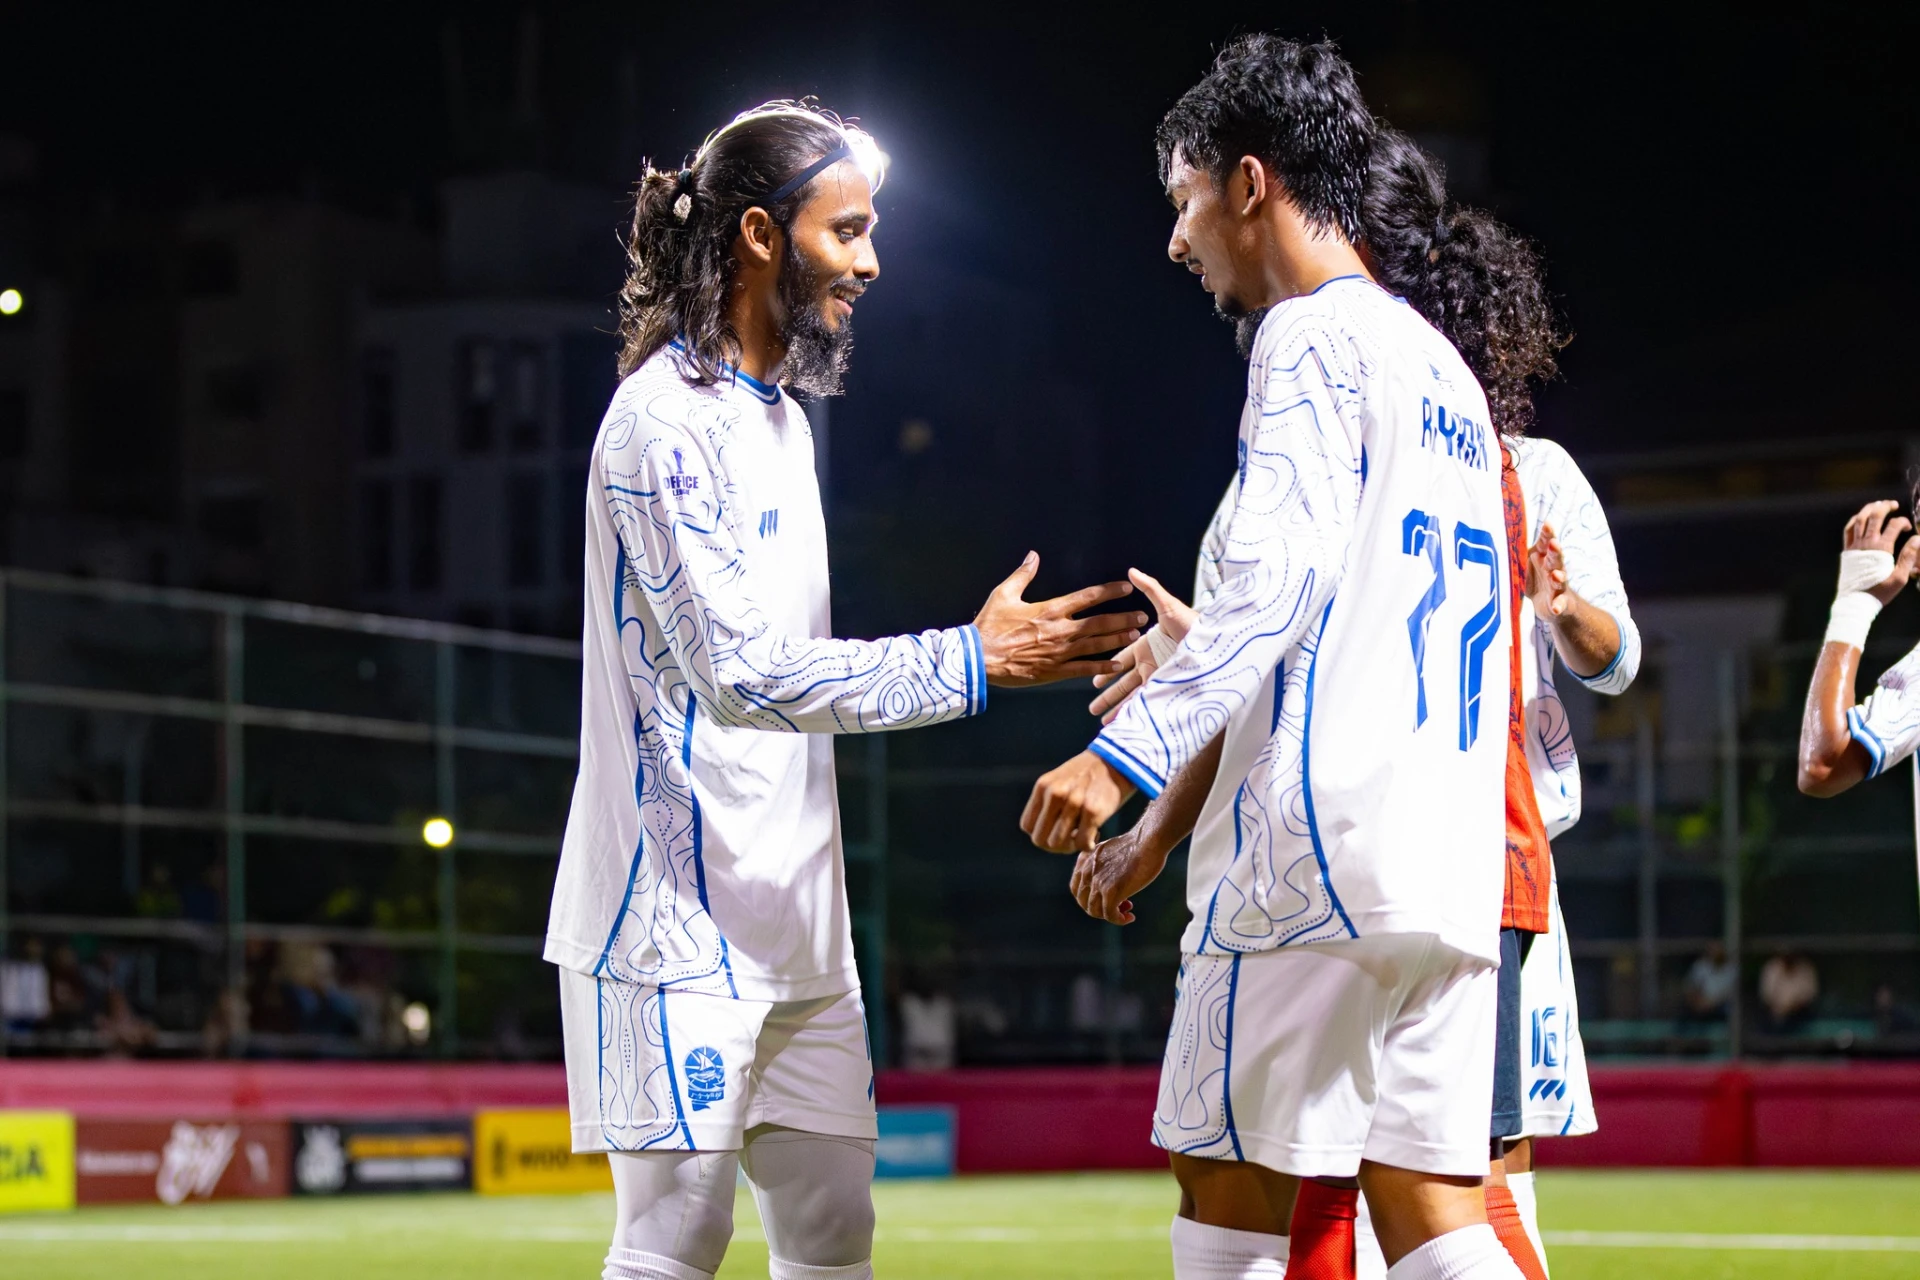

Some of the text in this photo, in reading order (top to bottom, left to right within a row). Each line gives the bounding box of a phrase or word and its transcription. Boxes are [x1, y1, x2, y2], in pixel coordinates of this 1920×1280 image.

[663, 475, 699, 489] OFFICE
[1402, 508, 1501, 752] 77
[1531, 1006, 1559, 1068] 16
